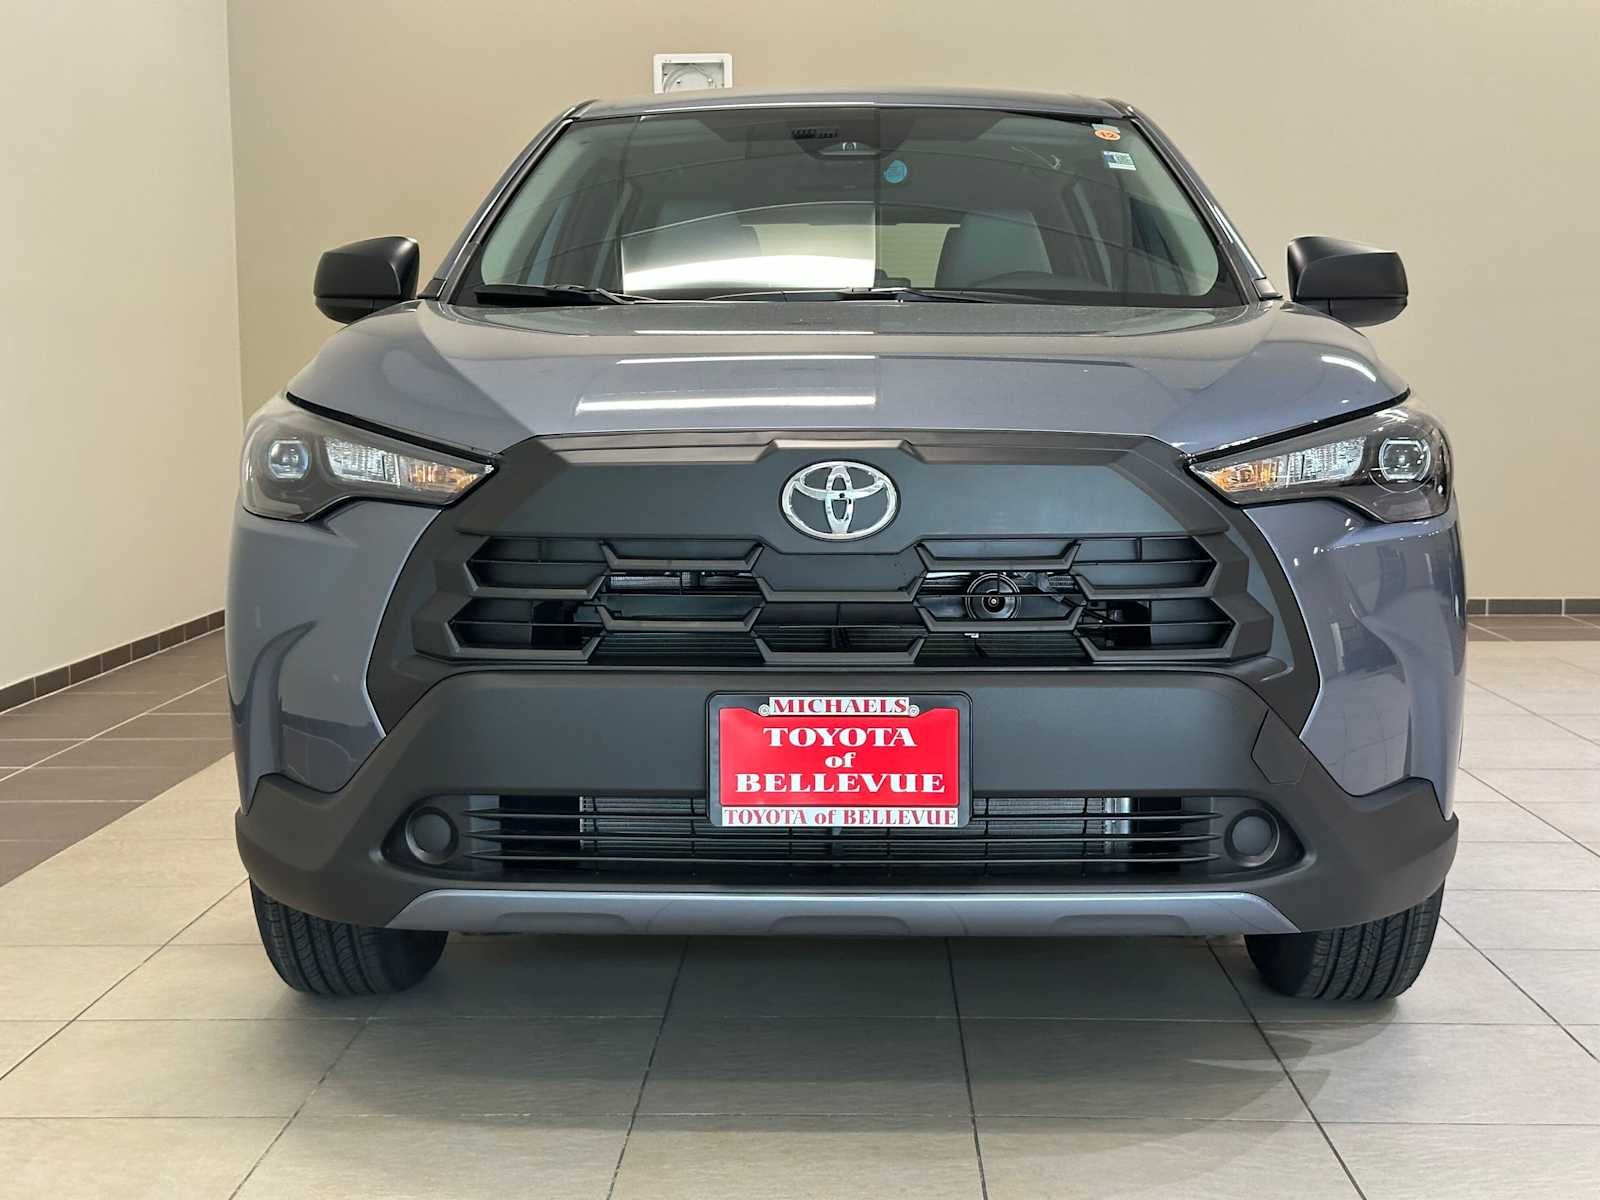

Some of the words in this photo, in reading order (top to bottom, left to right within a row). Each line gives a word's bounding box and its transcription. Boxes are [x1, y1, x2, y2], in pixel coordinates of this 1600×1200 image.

[773, 699, 907, 713] MICHAELS
[763, 728, 917, 747] TOYOTA
[824, 752, 856, 768] of
[736, 773, 945, 793] BELLEVUE
[724, 809, 807, 825] TOYOTA
[814, 808, 837, 825] of
[843, 809, 957, 825] BELLEVUE
